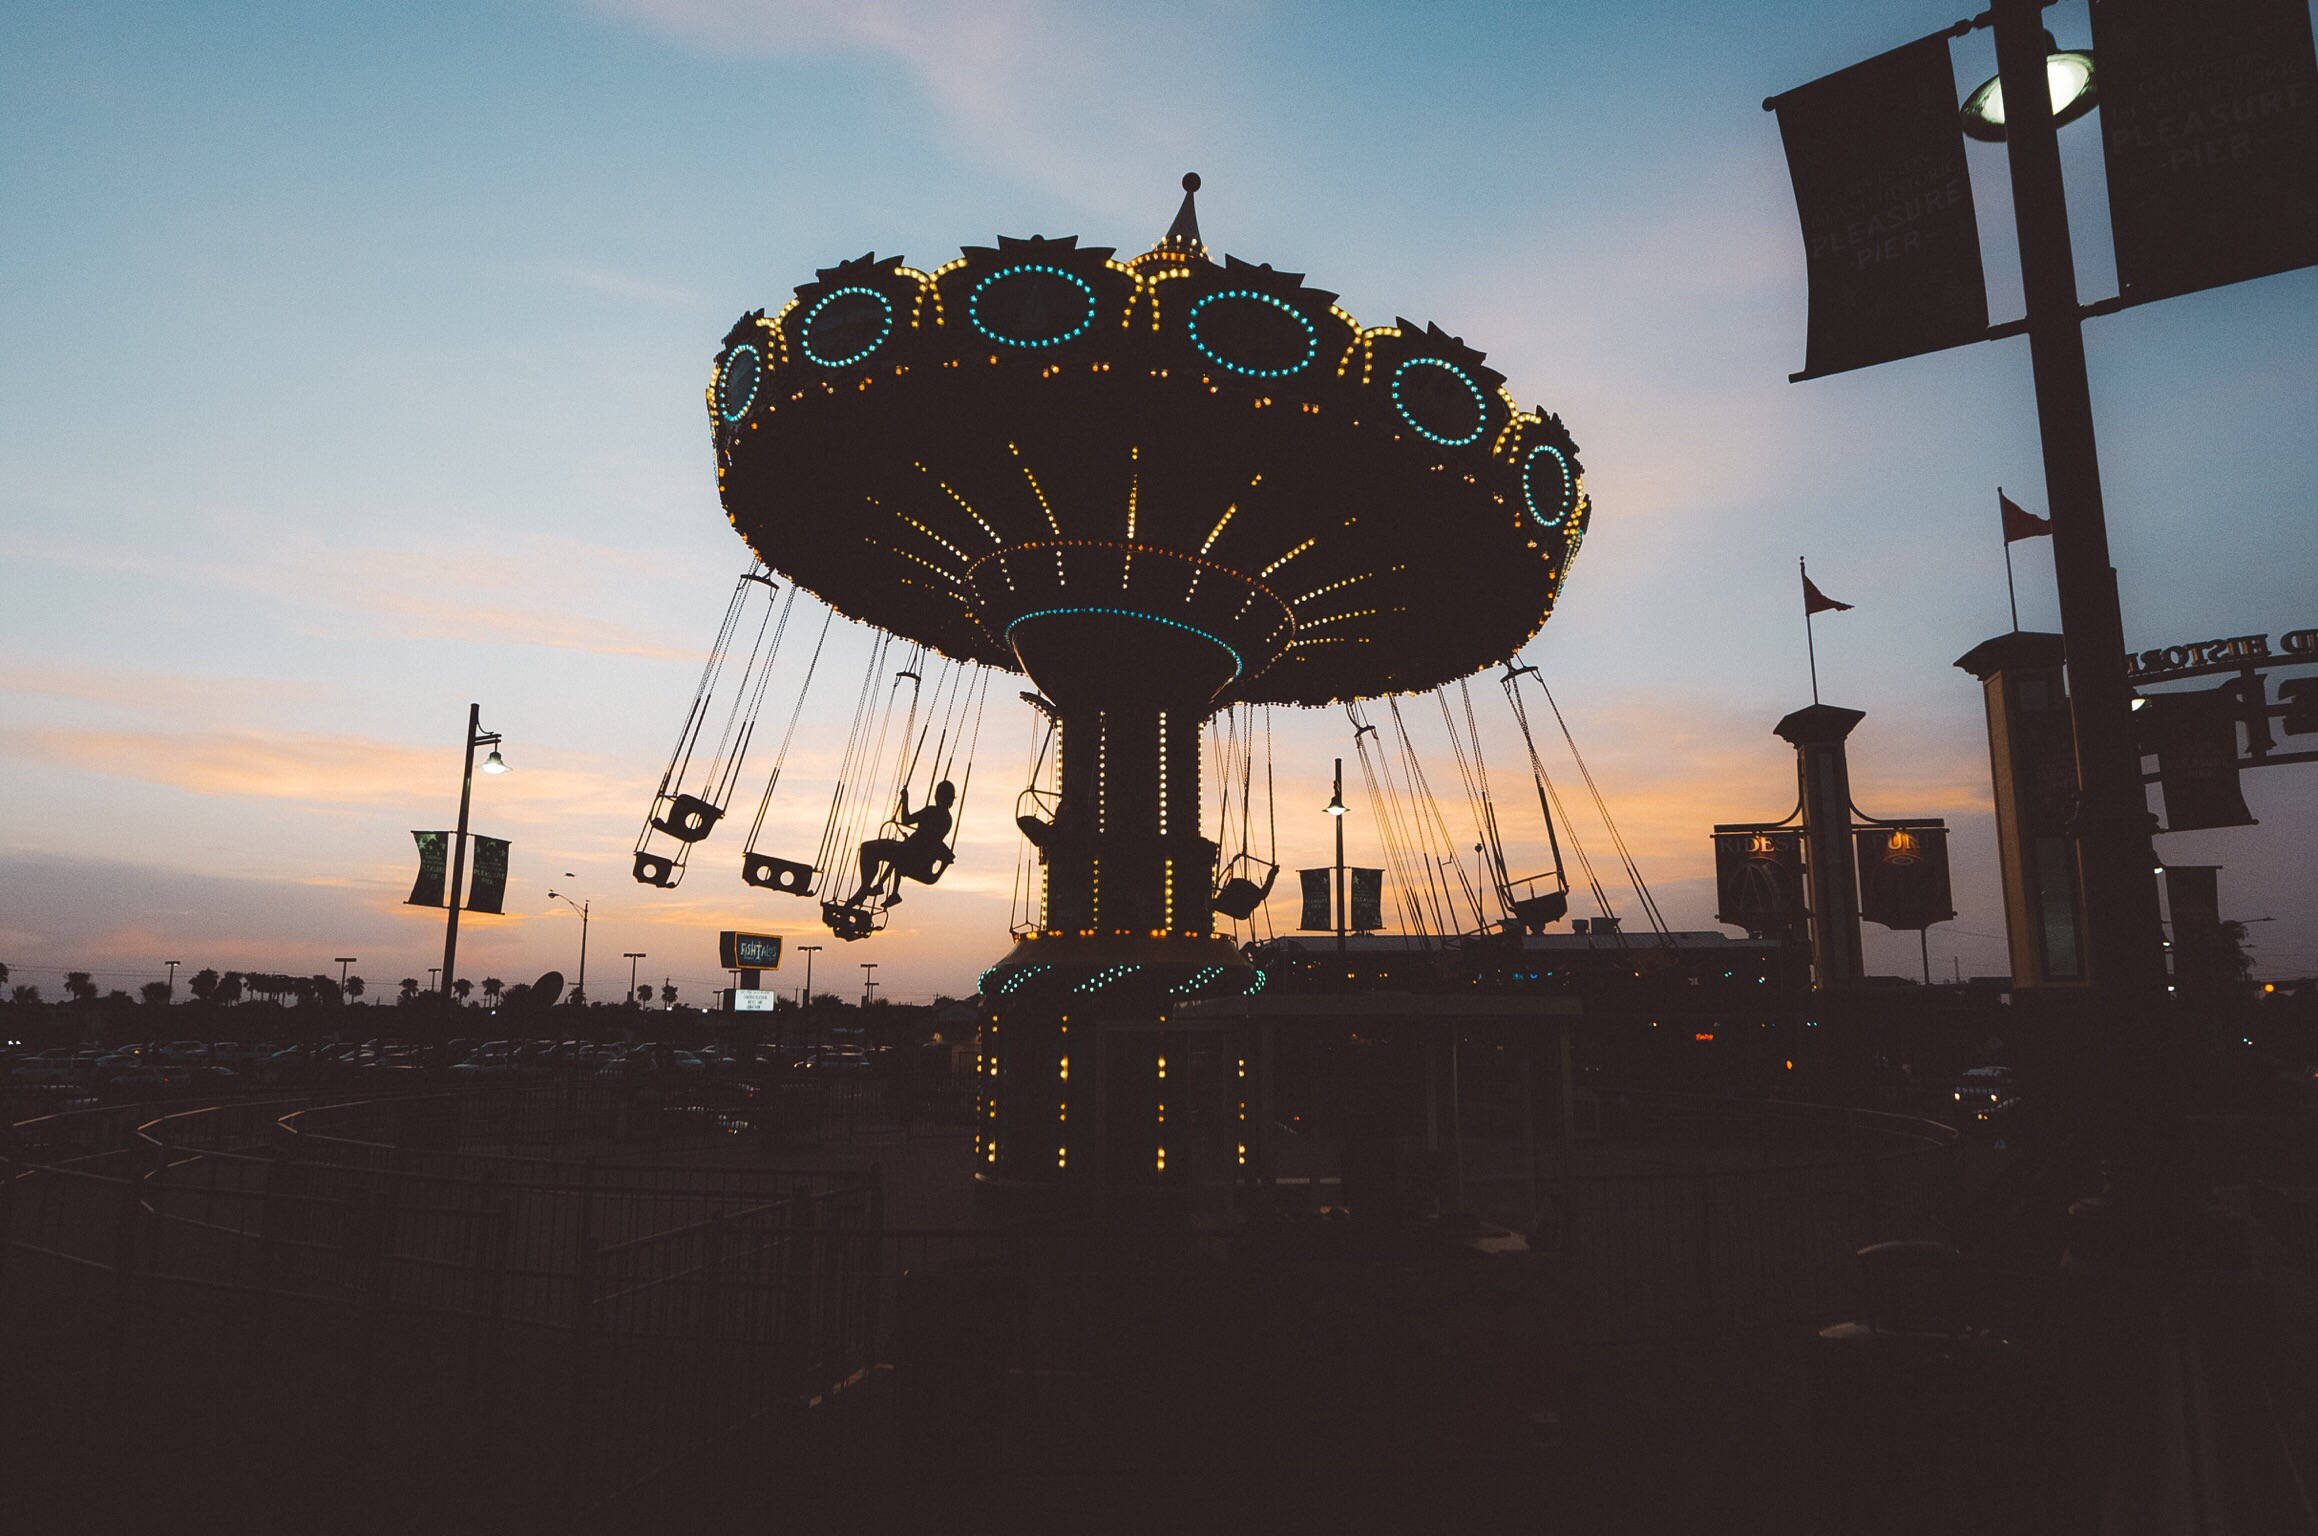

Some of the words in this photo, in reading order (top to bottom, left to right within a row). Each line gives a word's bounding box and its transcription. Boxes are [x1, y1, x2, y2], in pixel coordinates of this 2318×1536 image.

[2111, 82, 2311, 154] PLEASURE
[2169, 131, 2254, 172] PIER
[1811, 178, 1963, 259] PLEASURE
[1857, 229, 1921, 272] PIER
